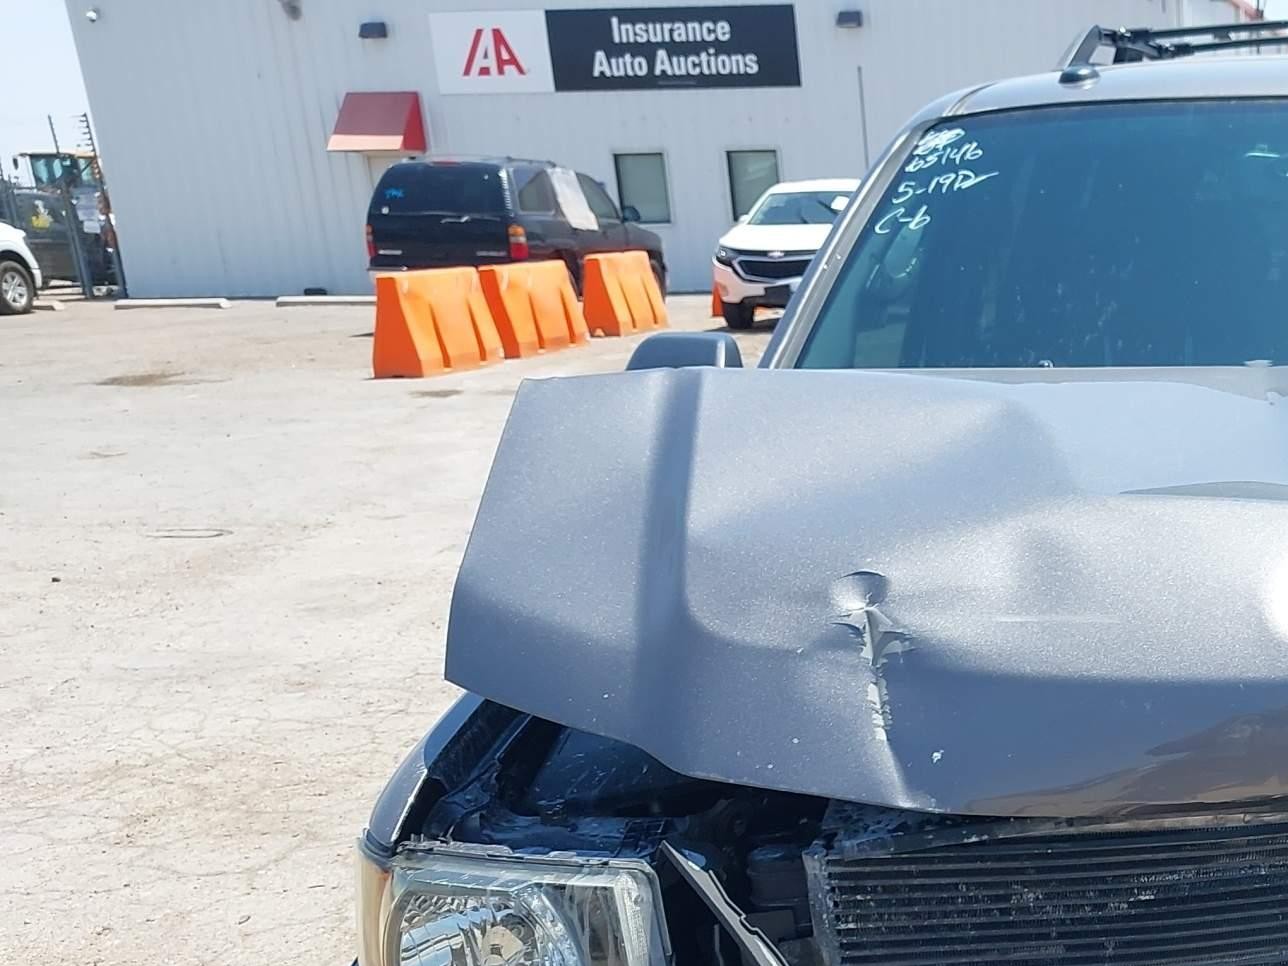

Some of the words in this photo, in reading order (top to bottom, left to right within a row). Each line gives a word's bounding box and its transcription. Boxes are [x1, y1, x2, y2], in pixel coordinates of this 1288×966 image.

[610, 16, 731, 44] Insurance
[592, 50, 649, 78] Auto
[653, 48, 760, 77] Auctions
